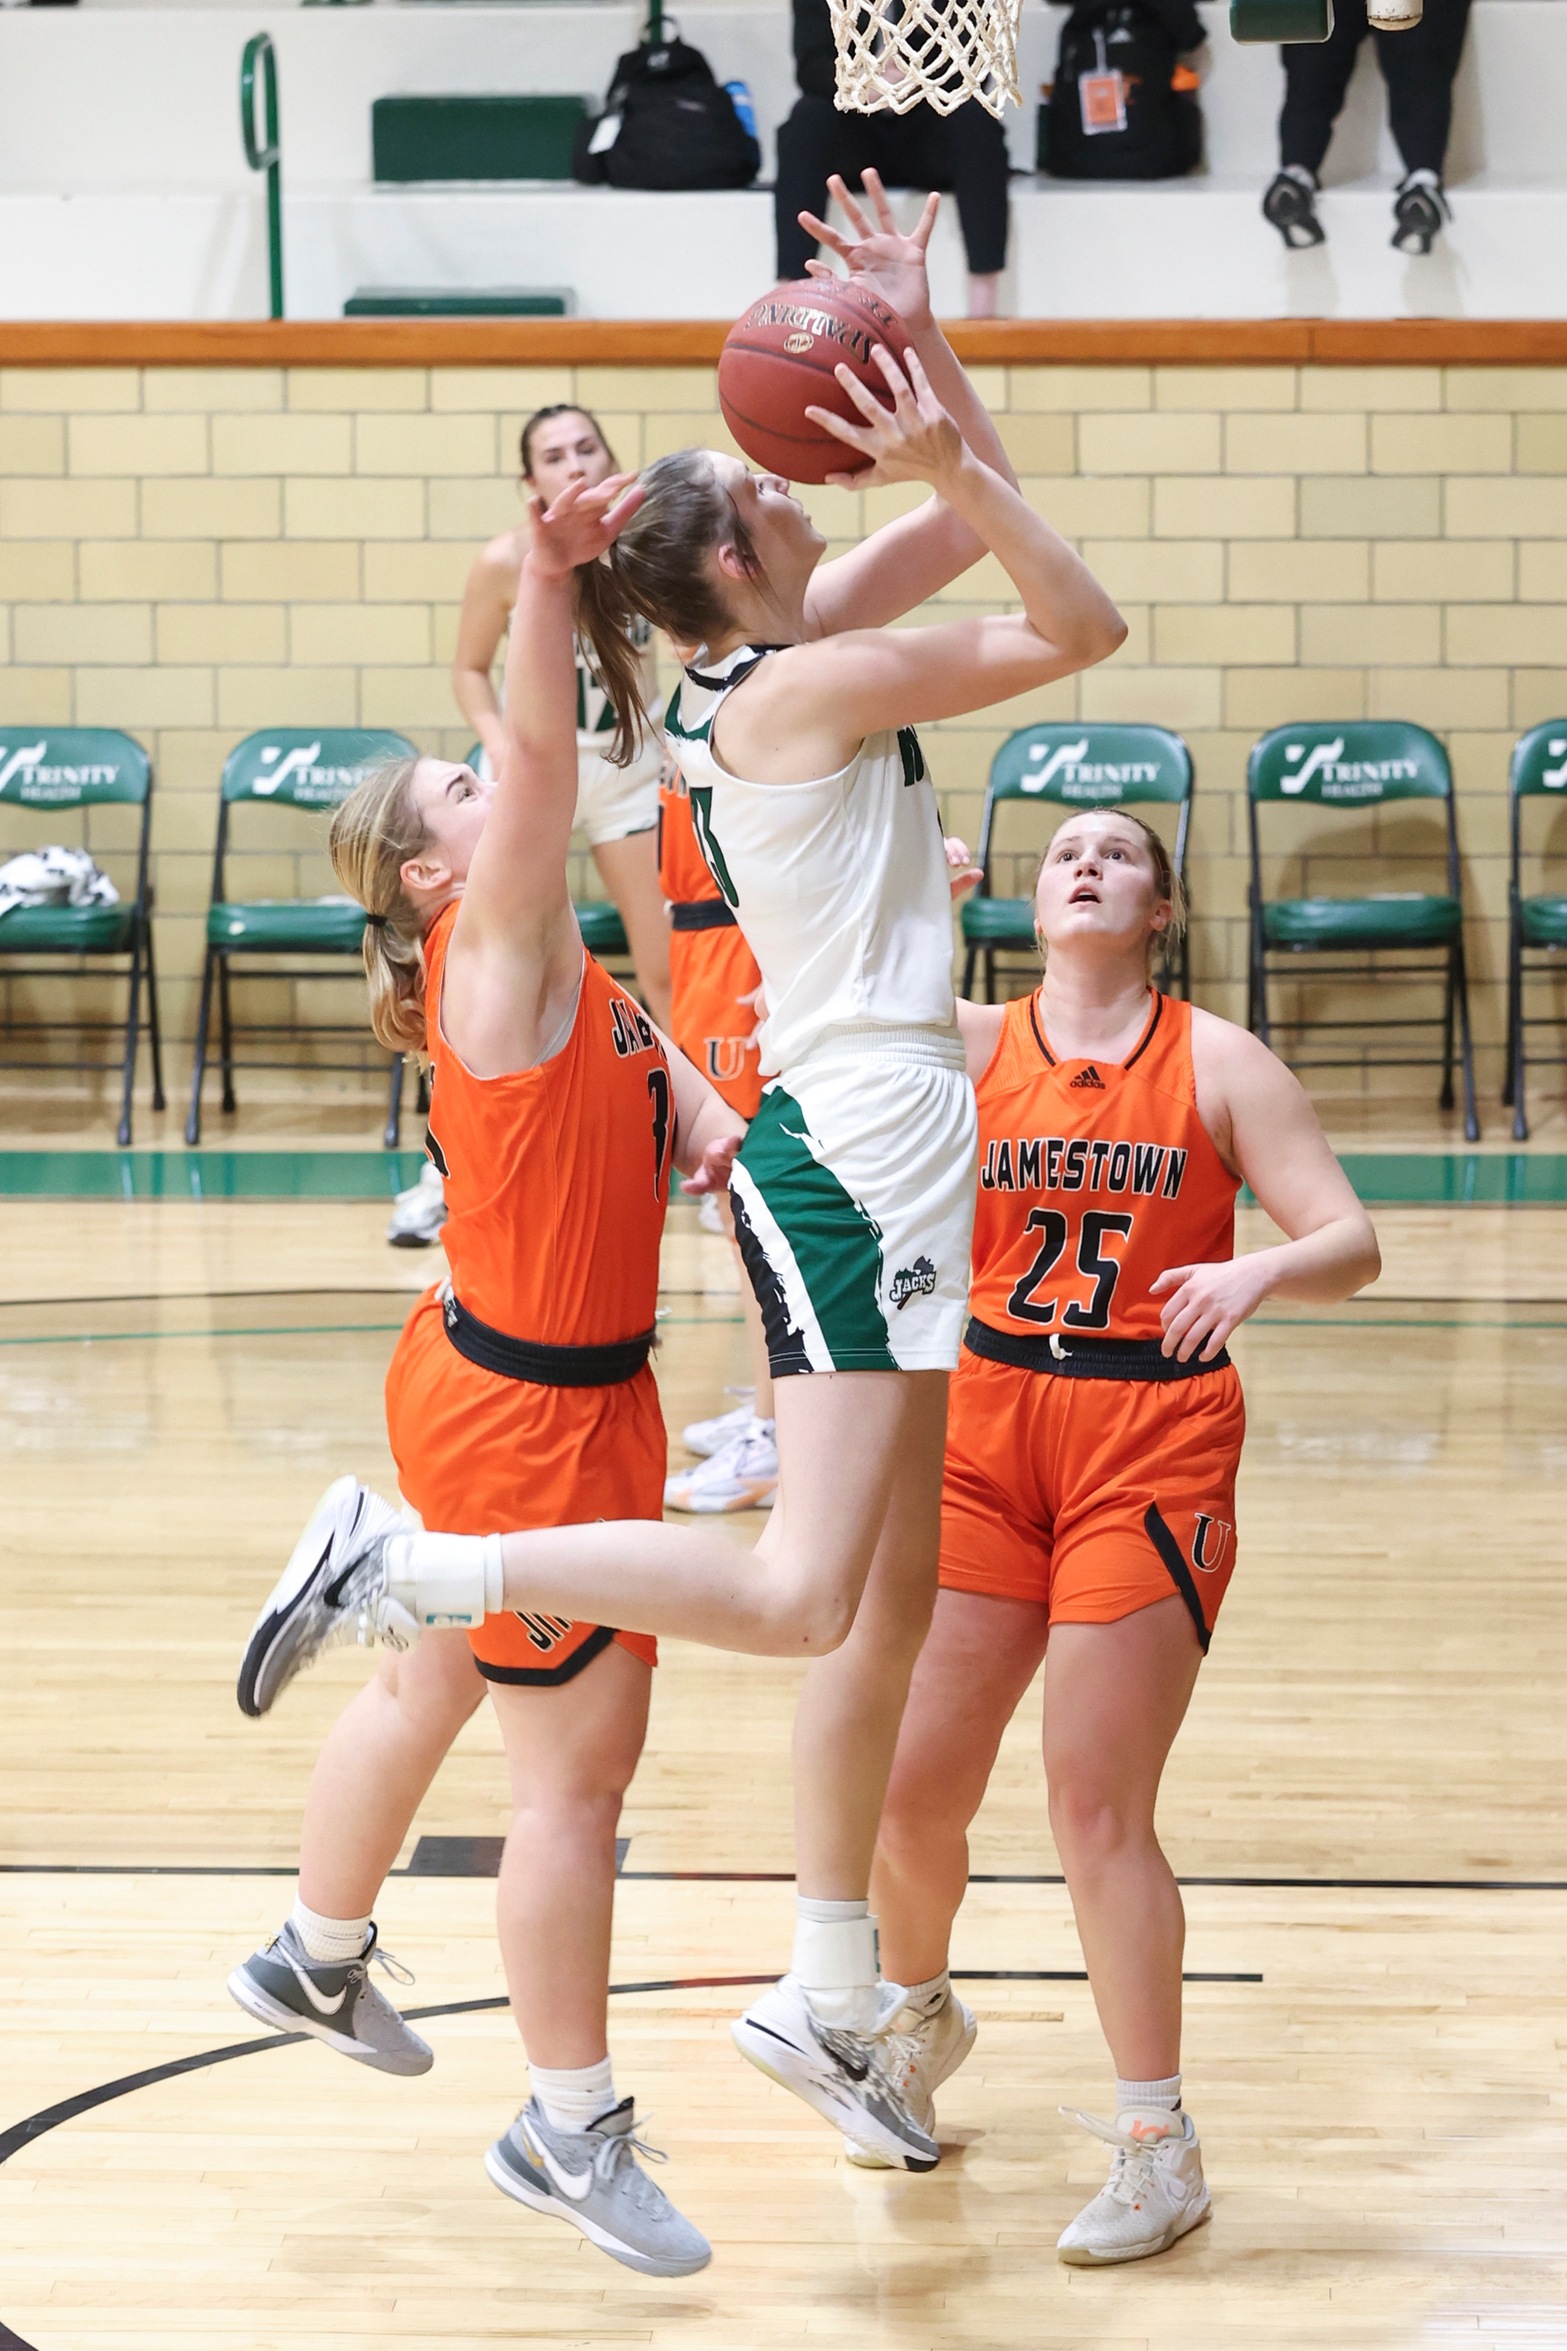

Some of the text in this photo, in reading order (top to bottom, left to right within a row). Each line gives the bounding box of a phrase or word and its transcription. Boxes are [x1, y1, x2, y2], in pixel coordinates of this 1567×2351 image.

[20, 764, 120, 785] TRINITY
[1061, 762, 1161, 783] TRINITY
[1320, 760, 1420, 783] TRINITY
[1070, 1079, 1106, 1090] adidas
[980, 1137, 1189, 1200] JAMESTOWN
[1007, 1208, 1134, 1330] 25
[889, 1271, 937, 1302] JACKS
